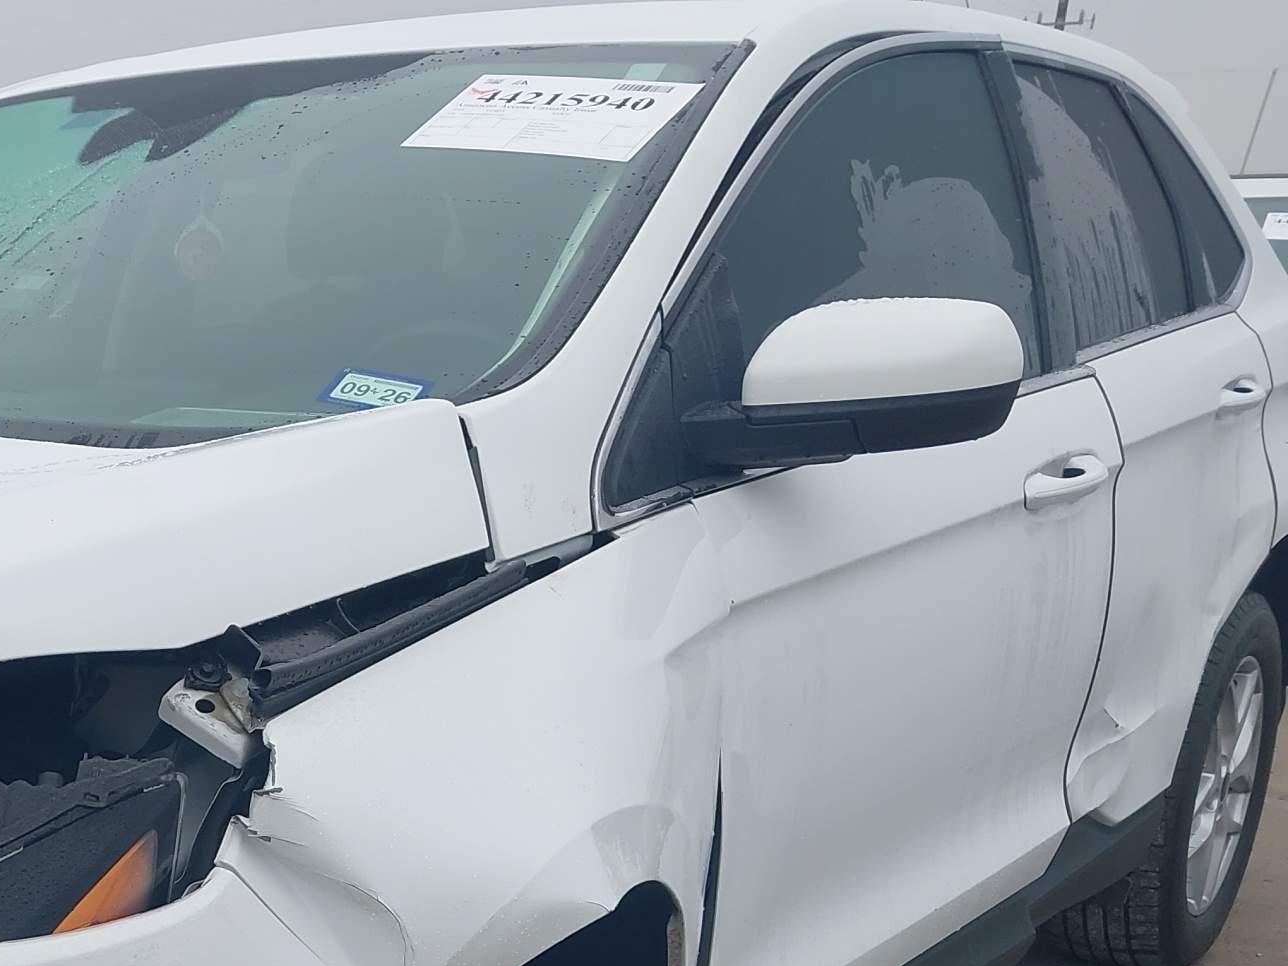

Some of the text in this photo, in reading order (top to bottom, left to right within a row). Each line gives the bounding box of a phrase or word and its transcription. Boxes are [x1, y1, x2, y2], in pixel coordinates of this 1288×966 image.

[477, 90, 655, 111] 44215940
[339, 381, 371, 397] 09
[377, 388, 412, 404] 26
